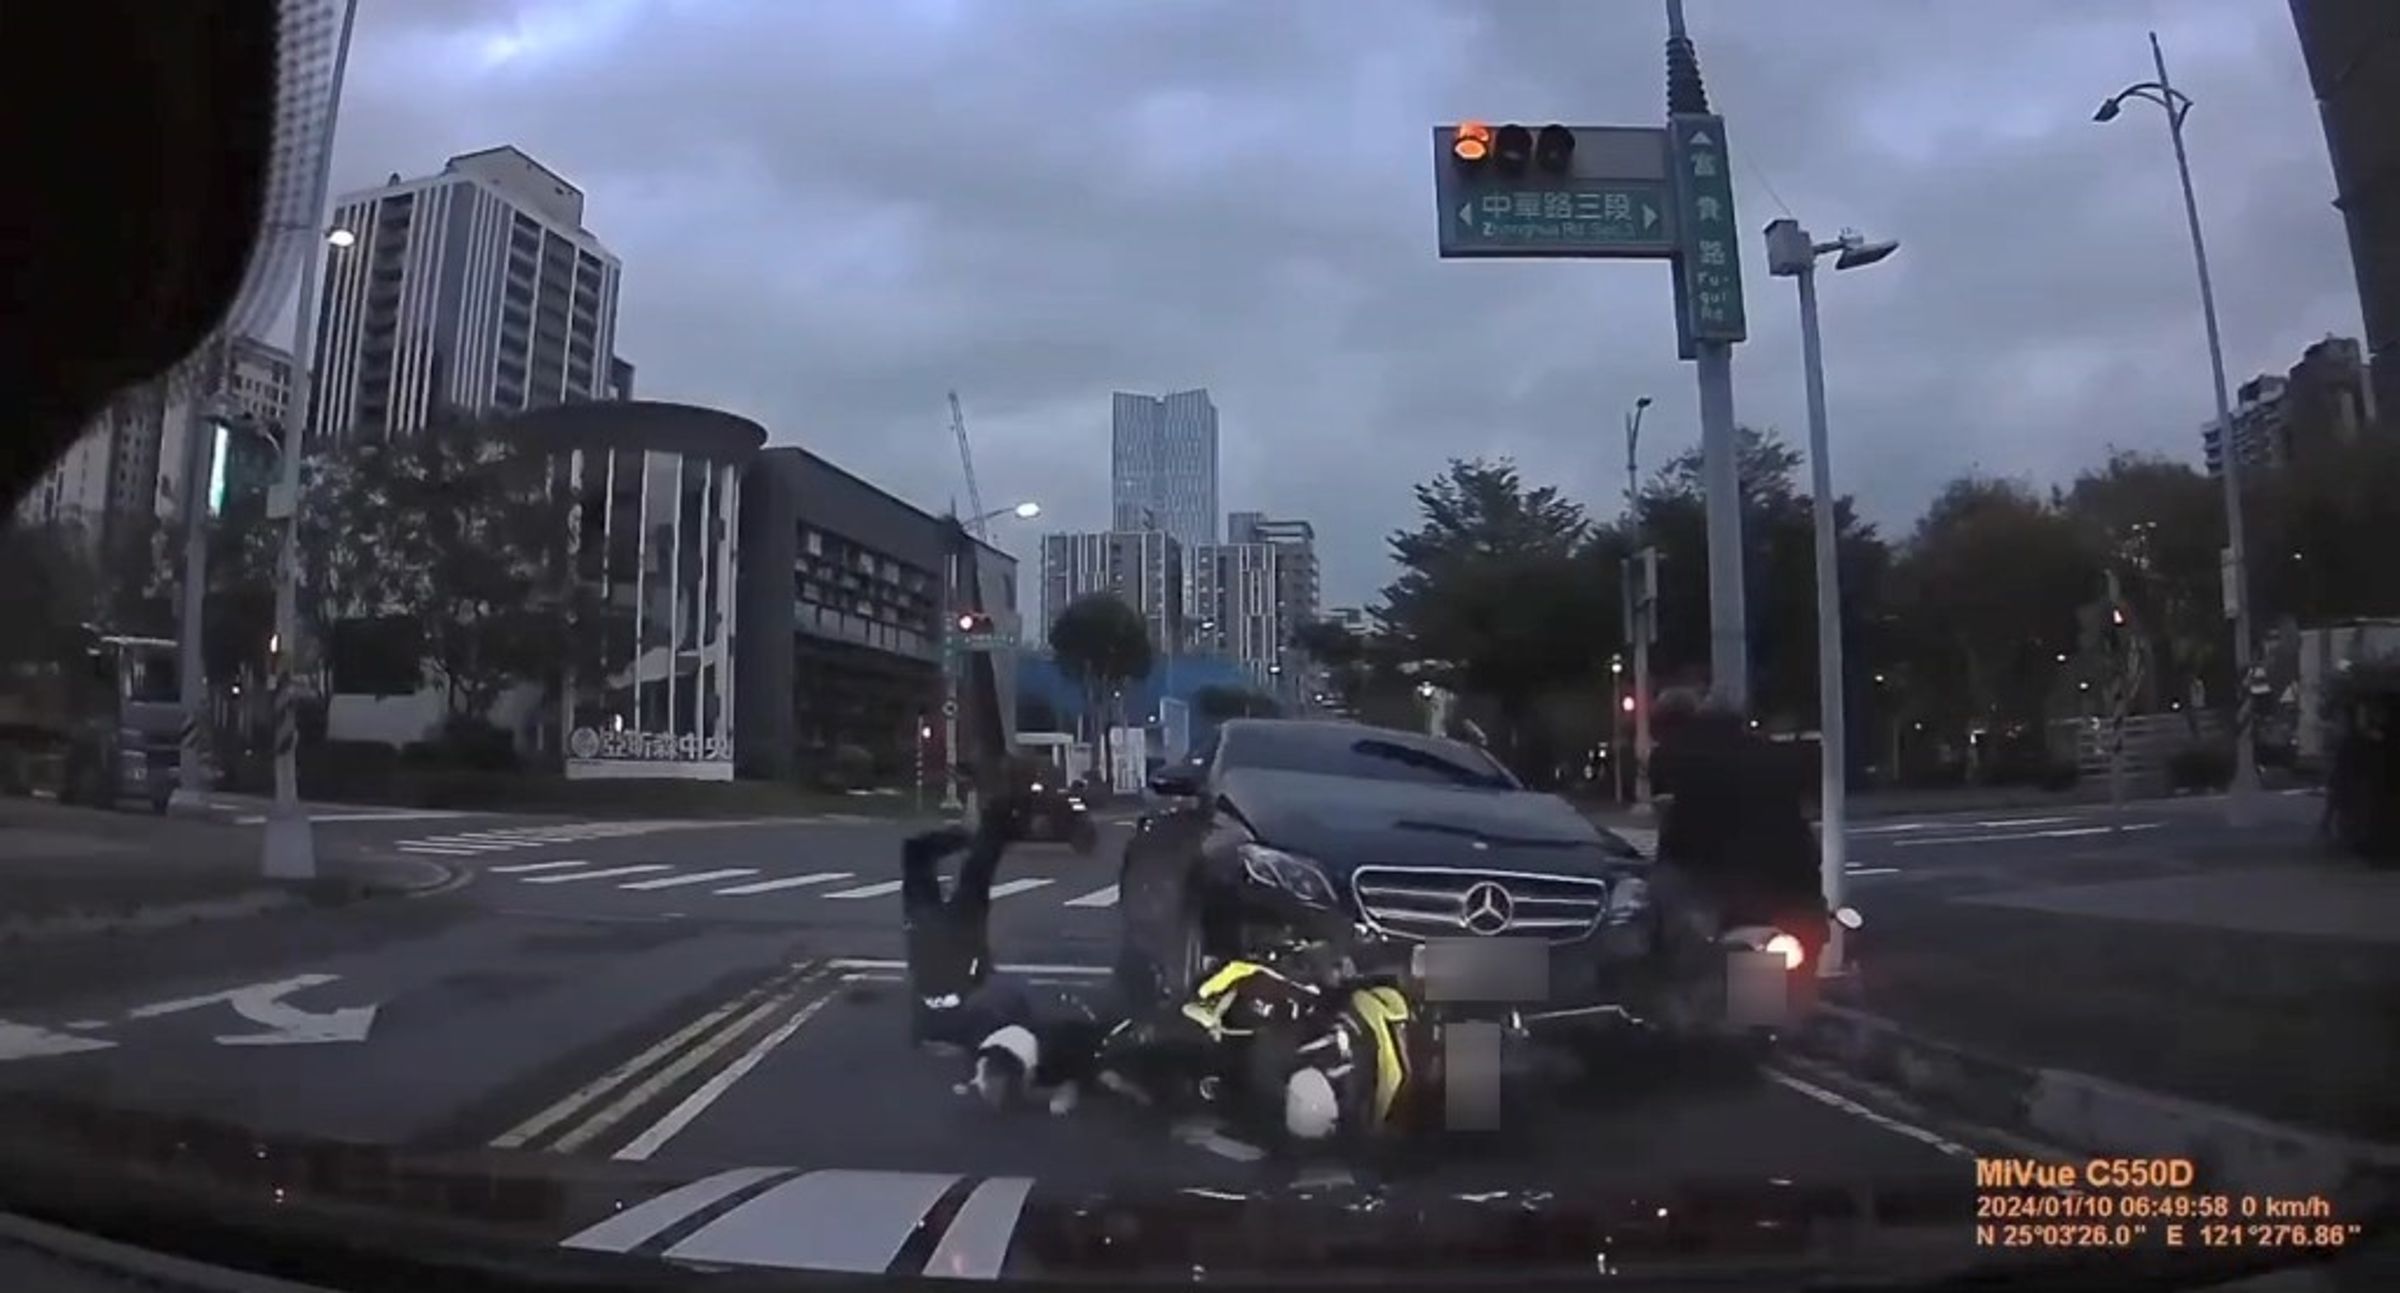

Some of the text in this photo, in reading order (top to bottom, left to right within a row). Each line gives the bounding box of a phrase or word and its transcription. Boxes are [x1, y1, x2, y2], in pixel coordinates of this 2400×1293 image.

[1482, 191, 1634, 222] 中華路三段
[1691, 151, 1726, 266] 富貴路
